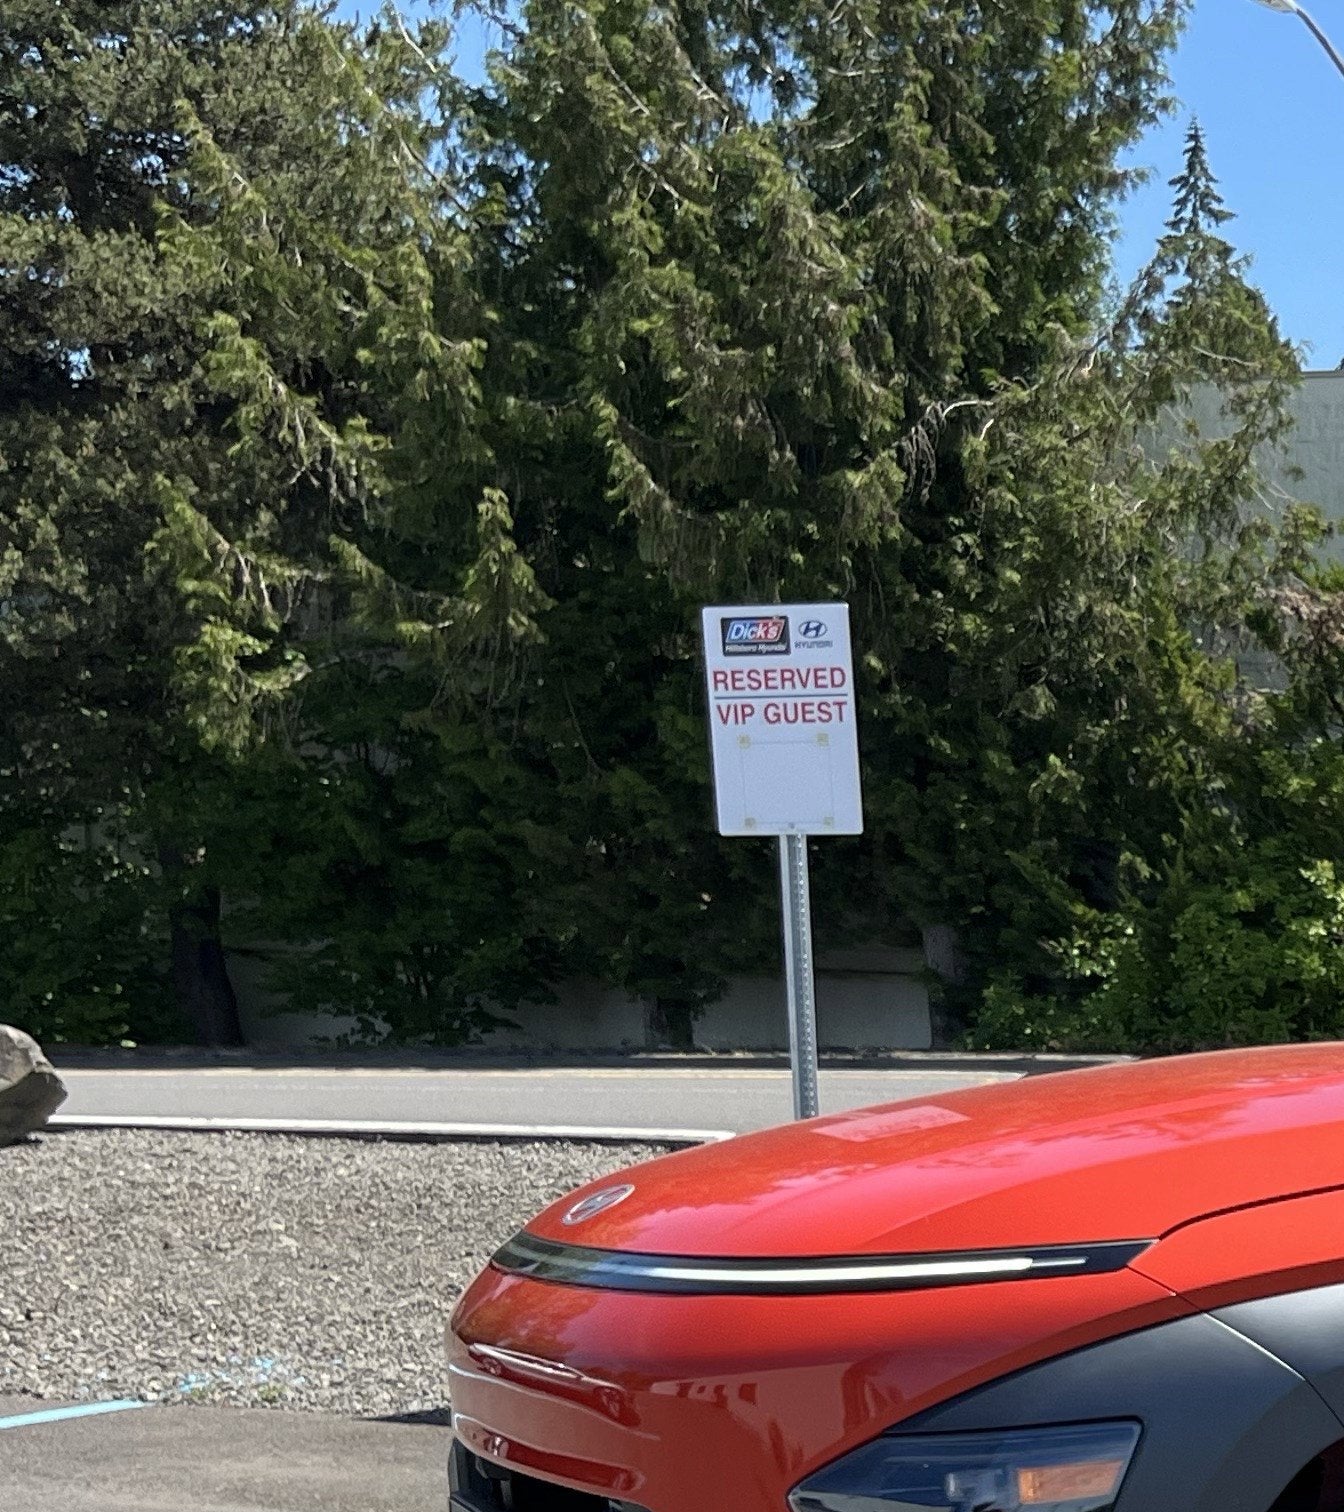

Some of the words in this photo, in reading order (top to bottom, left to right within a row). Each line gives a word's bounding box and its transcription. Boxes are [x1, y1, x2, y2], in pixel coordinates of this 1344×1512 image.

[713, 667, 846, 692] RESERVED
[716, 703, 755, 726] VIP
[764, 701, 848, 725] GUEST
